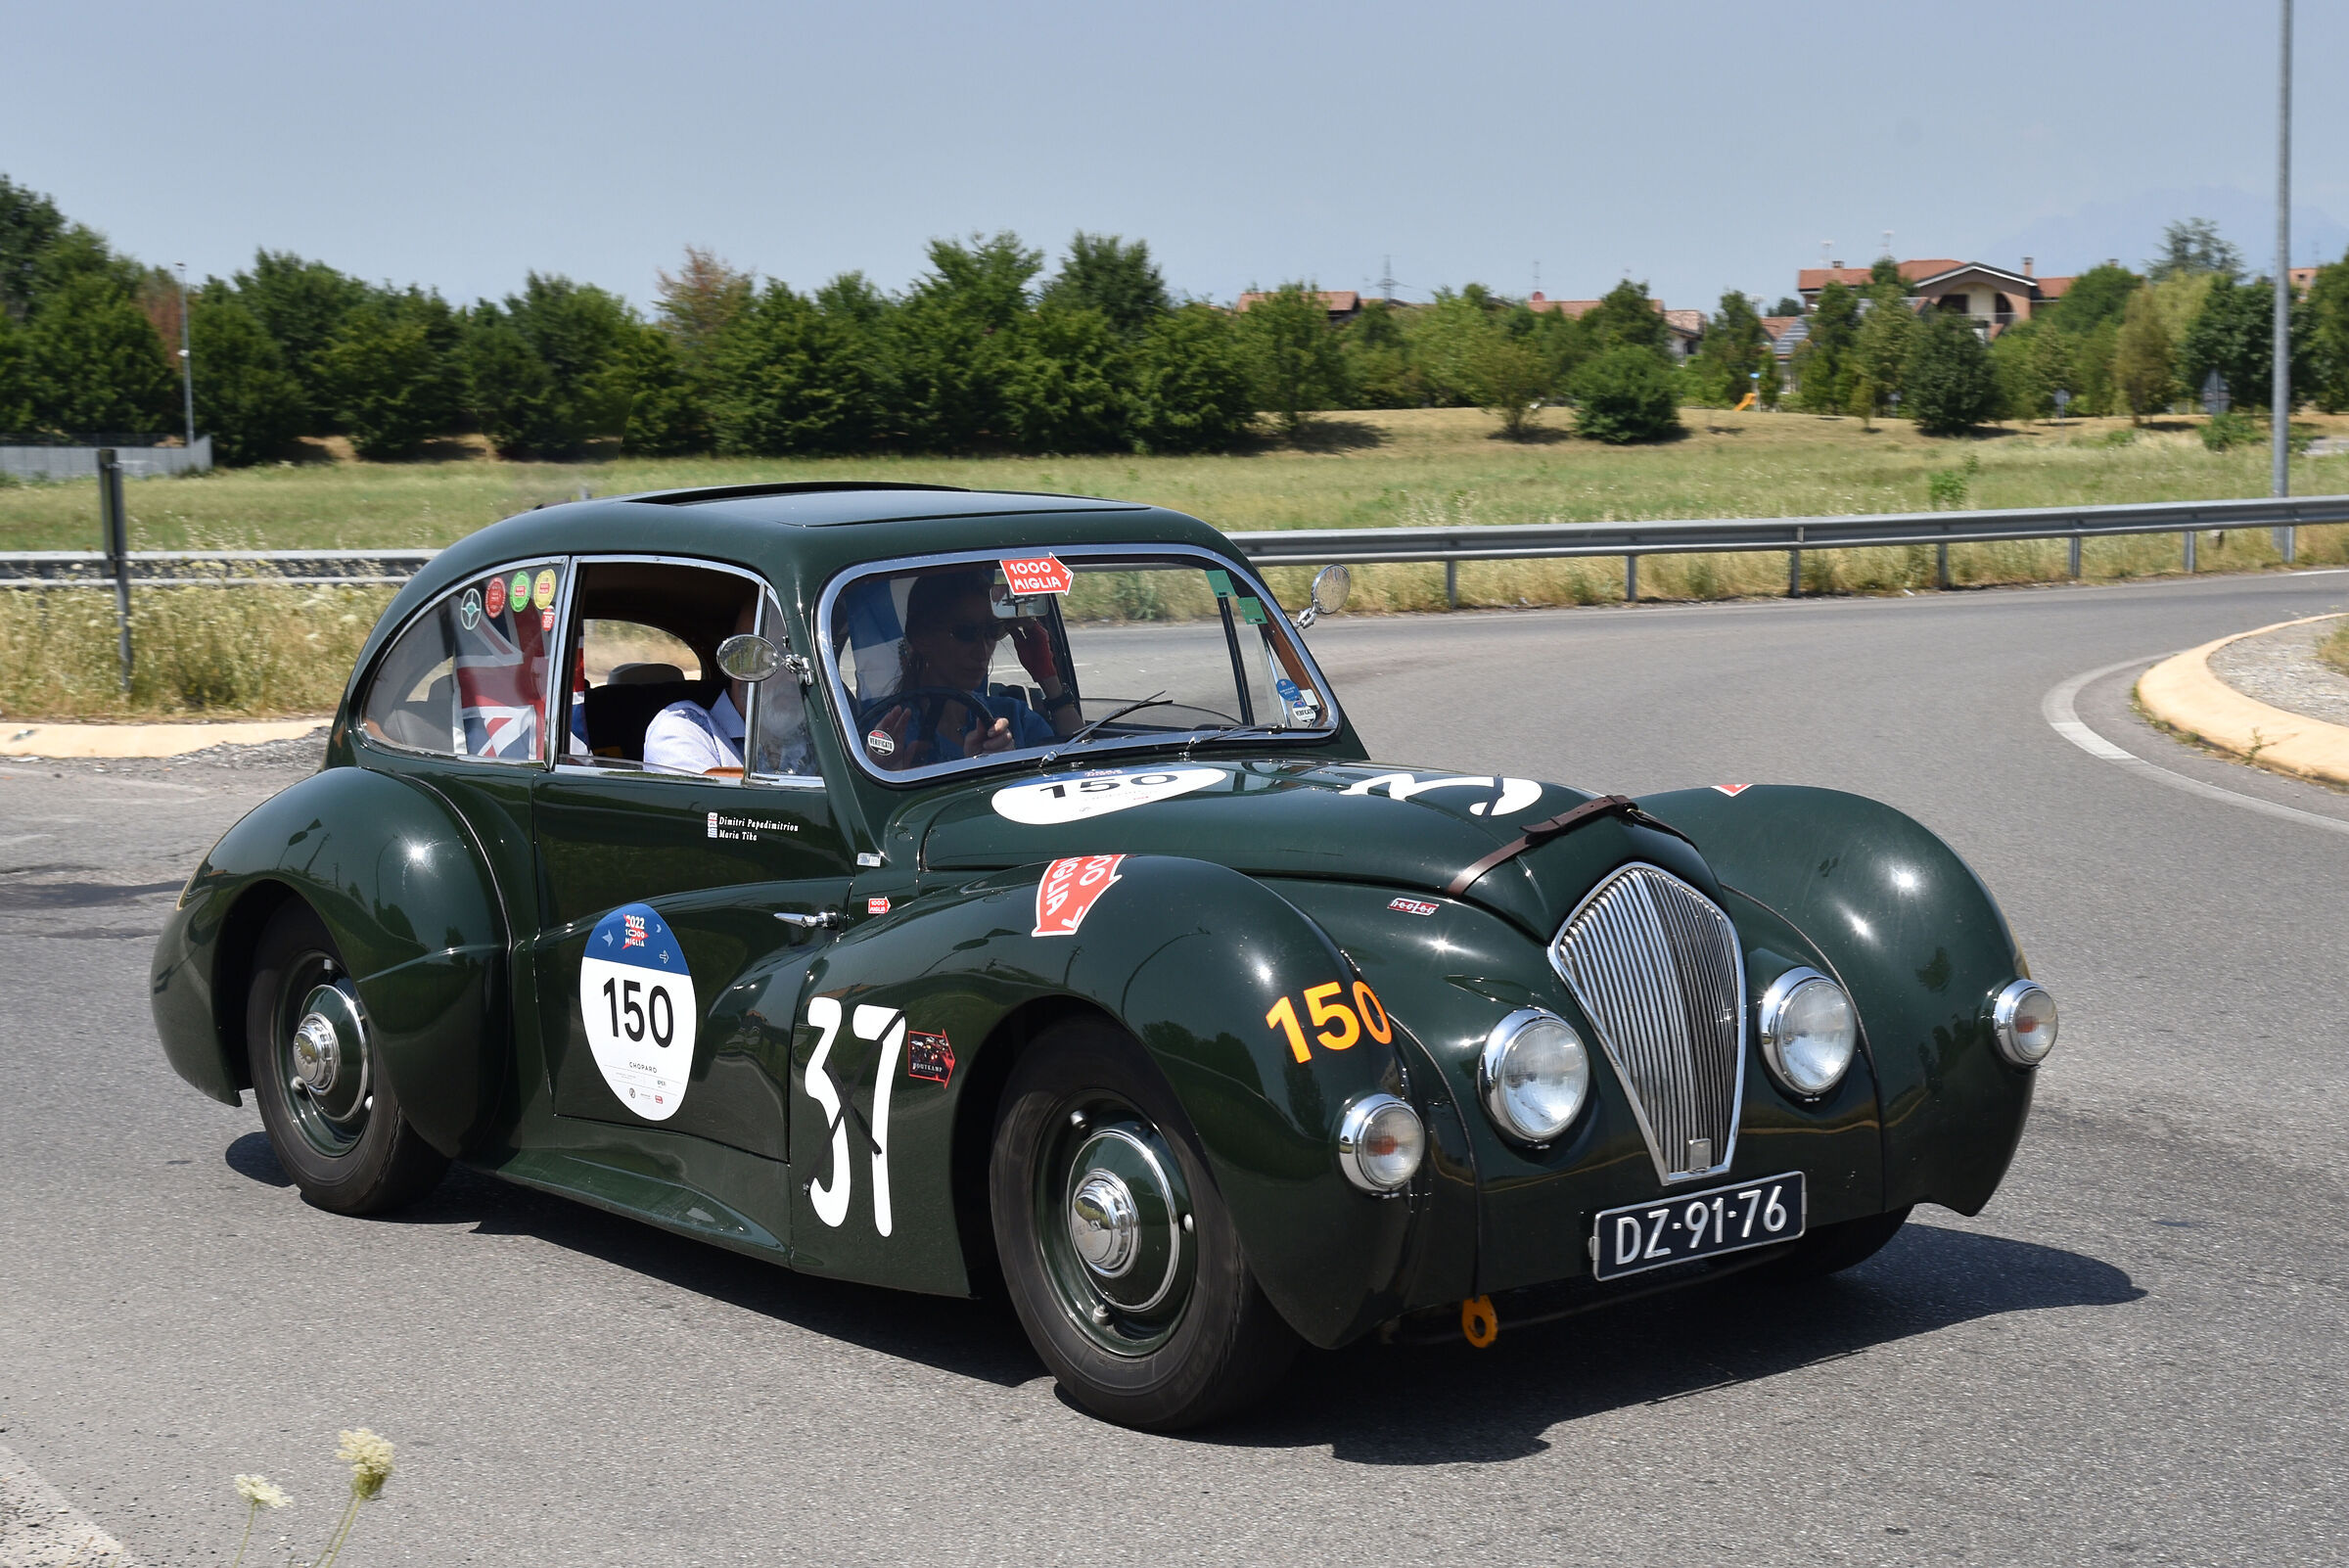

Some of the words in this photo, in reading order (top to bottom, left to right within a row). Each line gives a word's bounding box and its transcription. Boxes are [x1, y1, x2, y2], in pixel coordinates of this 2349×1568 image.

[1009, 561, 1052, 576] 1000
[1013, 576, 1062, 590] MIGLIA
[1039, 774, 1178, 799] 150
[718, 816, 746, 827] Dimitri
[718, 829, 740, 840] Maria
[1046, 856, 1083, 916] IGLIA
[624, 914, 645, 930] 2022
[624, 928, 645, 939] 1000
[624, 937, 645, 947] MIGLIA
[603, 977, 674, 1048] 150
[1266, 981, 1393, 1064] 150
[628, 1061, 658, 1074] CHOPARD
[804, 996, 906, 1238] 37
[1615, 1185, 1787, 1266] DZ-91-76
